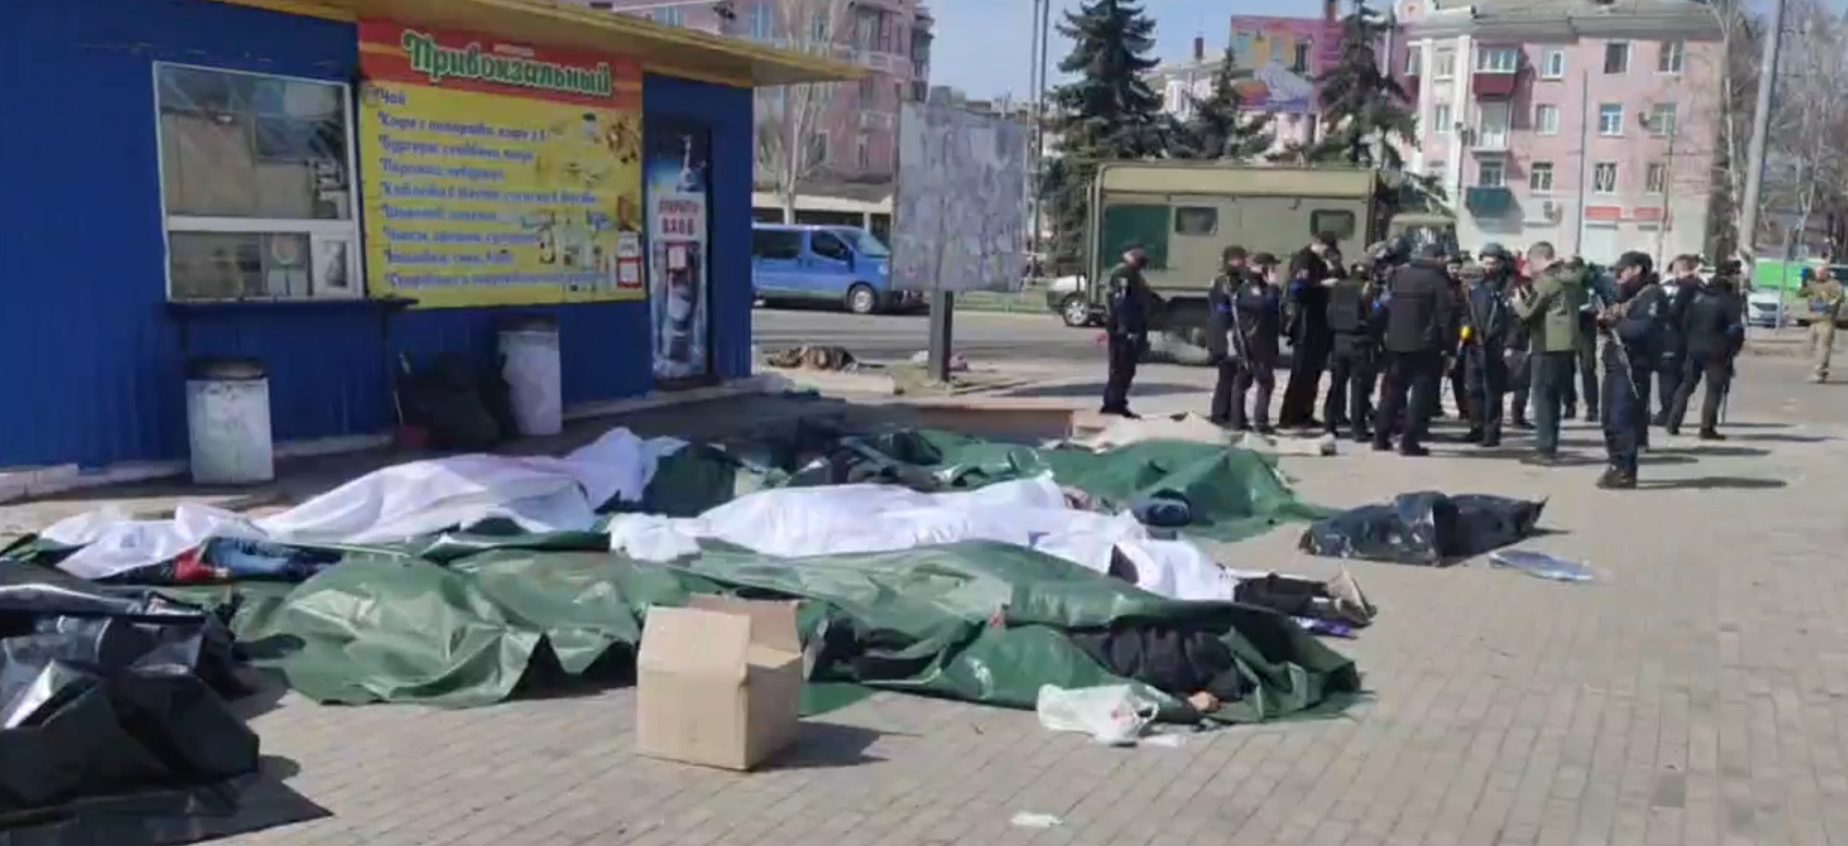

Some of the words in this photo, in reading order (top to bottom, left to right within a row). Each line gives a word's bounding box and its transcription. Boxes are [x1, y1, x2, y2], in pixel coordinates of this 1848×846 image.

[402, 29, 611, 96] Привокзальный
[377, 88, 406, 106] Чай
[377, 110, 417, 130] Кофе
[661, 216, 695, 235] ВХОД
